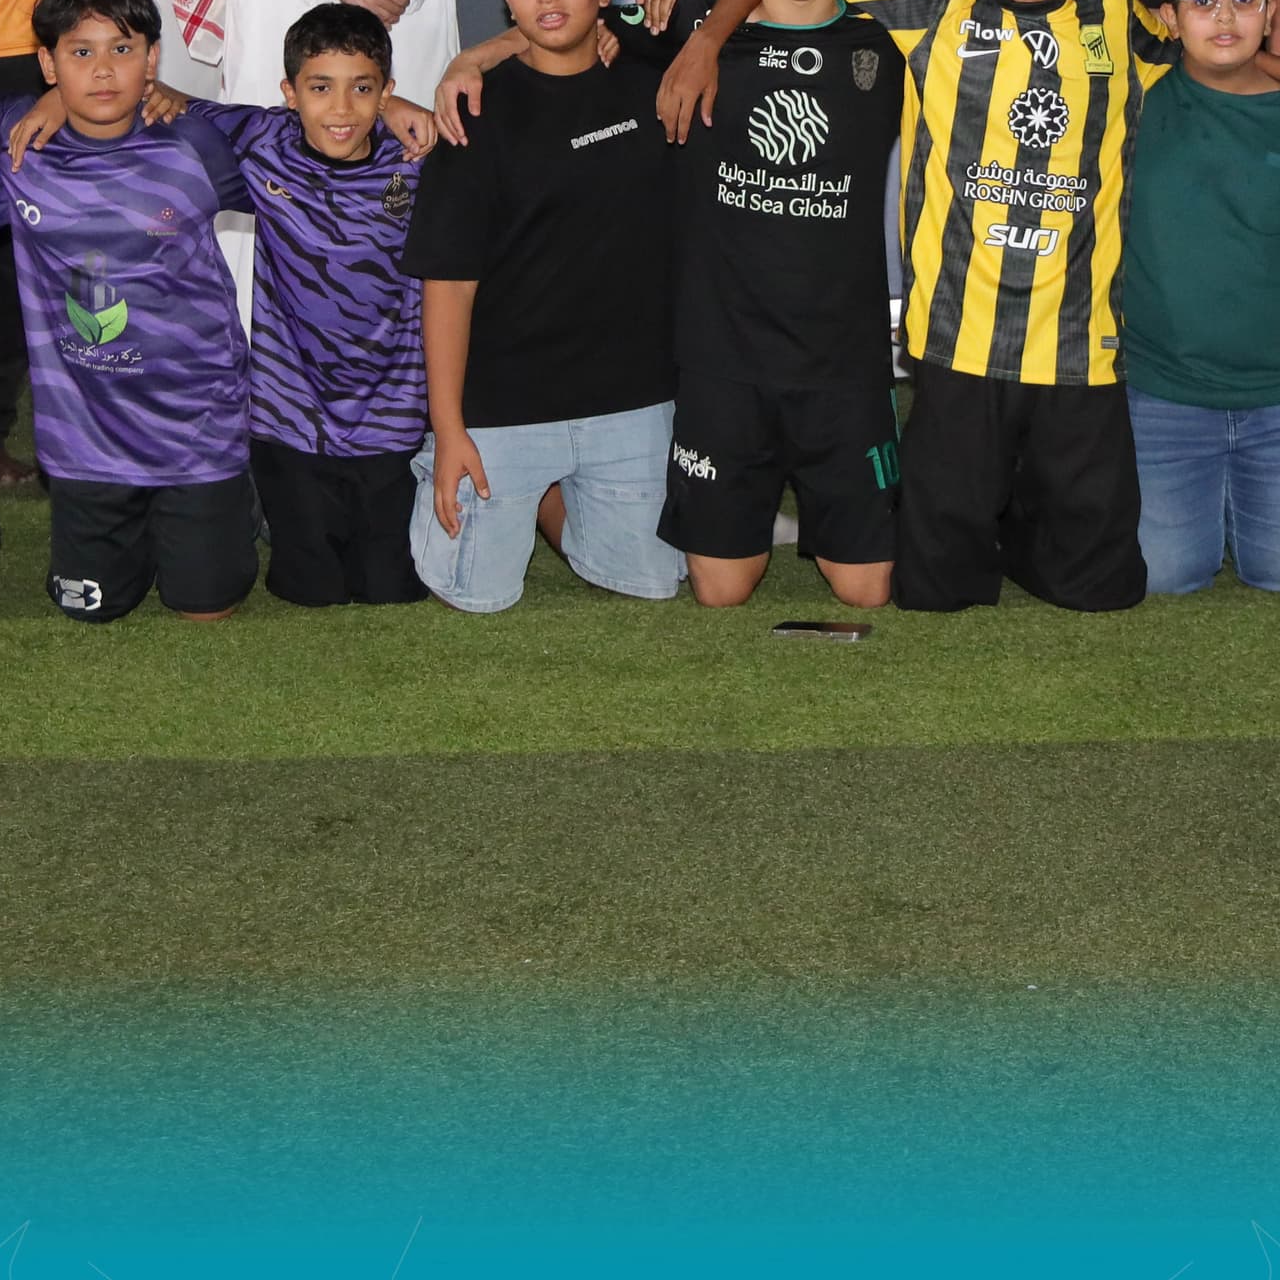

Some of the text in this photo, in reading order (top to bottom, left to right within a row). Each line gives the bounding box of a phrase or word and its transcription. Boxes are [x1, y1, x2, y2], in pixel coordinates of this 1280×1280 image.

[959, 19, 1014, 41] Flow
[758, 56, 787, 69] SIRC
[717, 160, 852, 197] البحر الأحمر الدولية
[966, 161, 1087, 192] مجموعة روشن
[717, 183, 848, 219] Red Sea Global
[963, 181, 1087, 212] ROSHN GROUP
